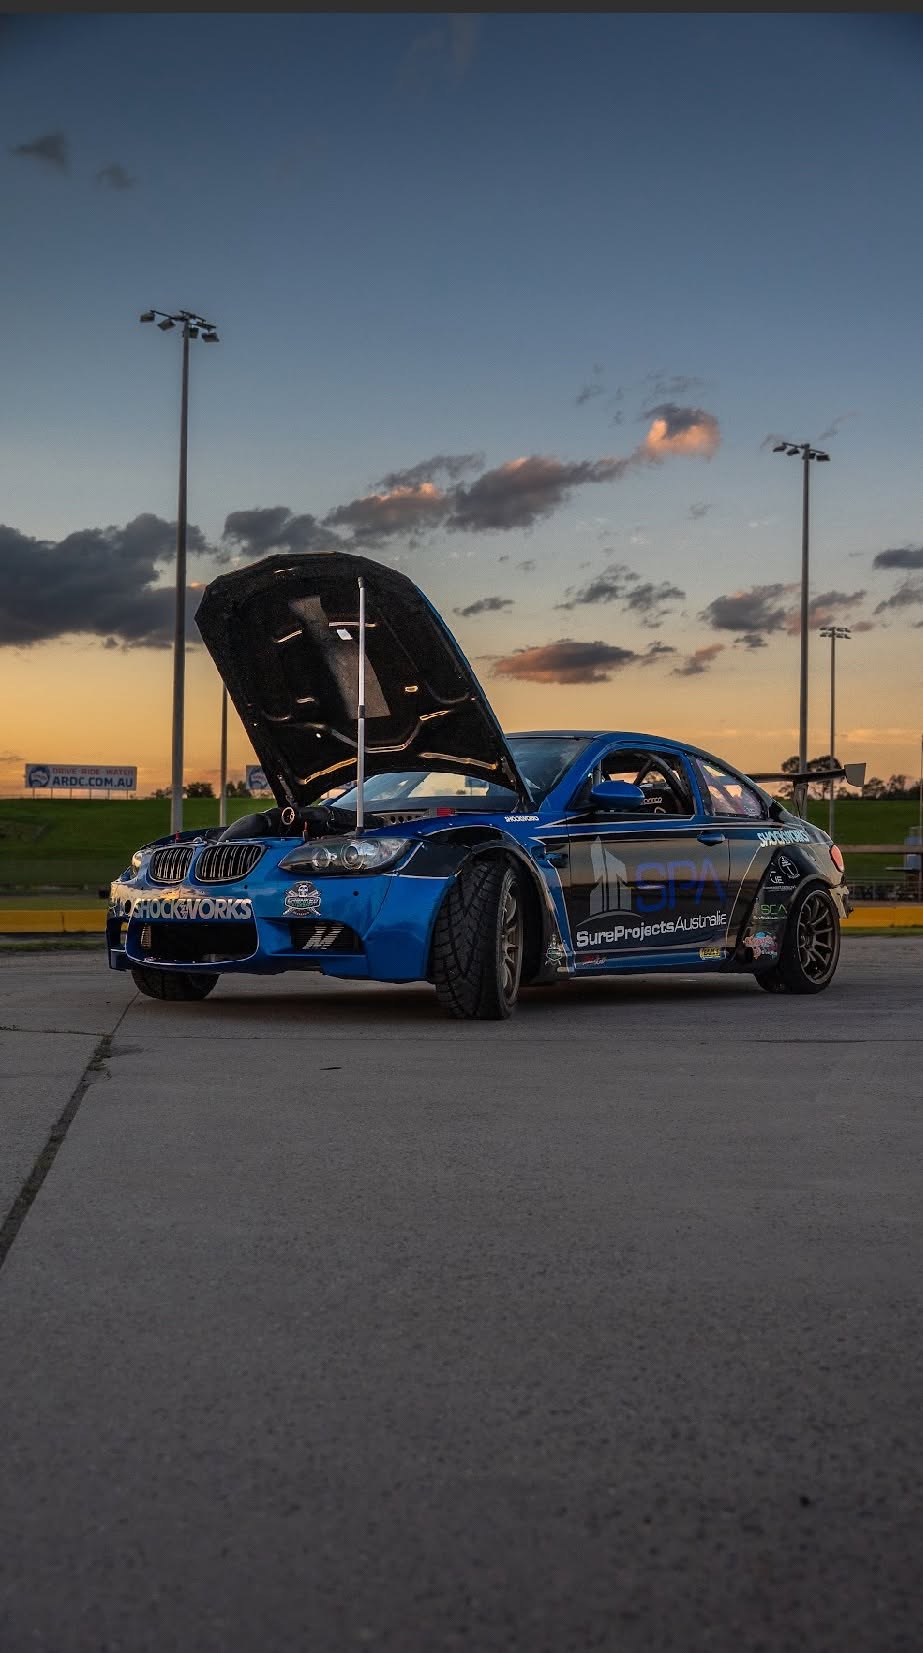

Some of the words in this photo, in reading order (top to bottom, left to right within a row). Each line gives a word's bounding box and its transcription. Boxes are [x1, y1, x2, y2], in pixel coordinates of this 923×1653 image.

[52, 776, 133, 788] ARDC.COM.AU
[635, 857, 726, 912] SPA
[132, 898, 252, 920] SHOCKWORKS
